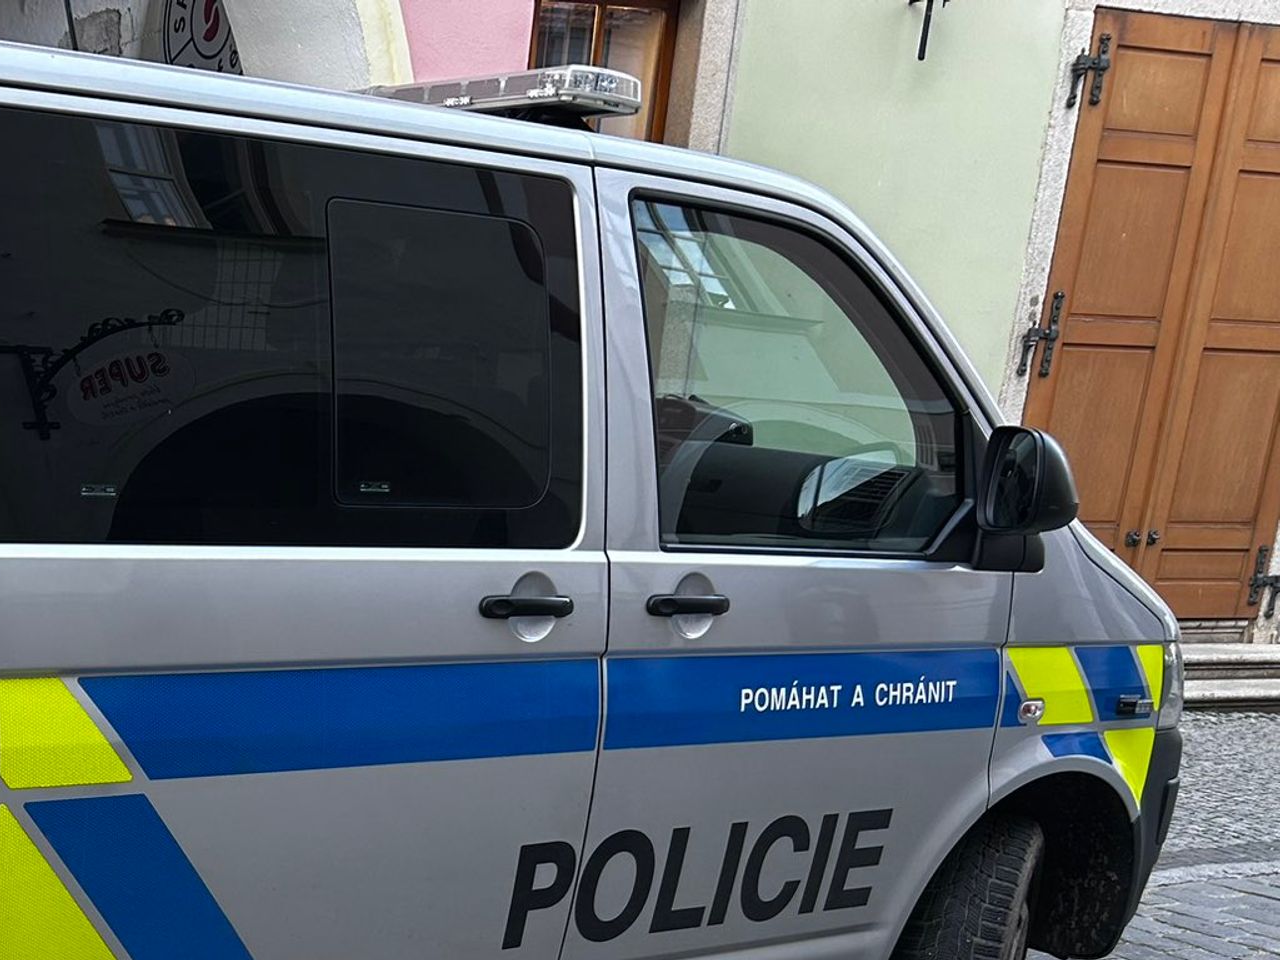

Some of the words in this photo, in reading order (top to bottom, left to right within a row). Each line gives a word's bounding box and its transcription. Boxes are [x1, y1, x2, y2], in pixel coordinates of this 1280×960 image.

[740, 680, 842, 712] POMÁHAT
[850, 685, 864, 707] A
[875, 676, 957, 706] CHRÁNIT
[501, 808, 894, 950] POLICIE
